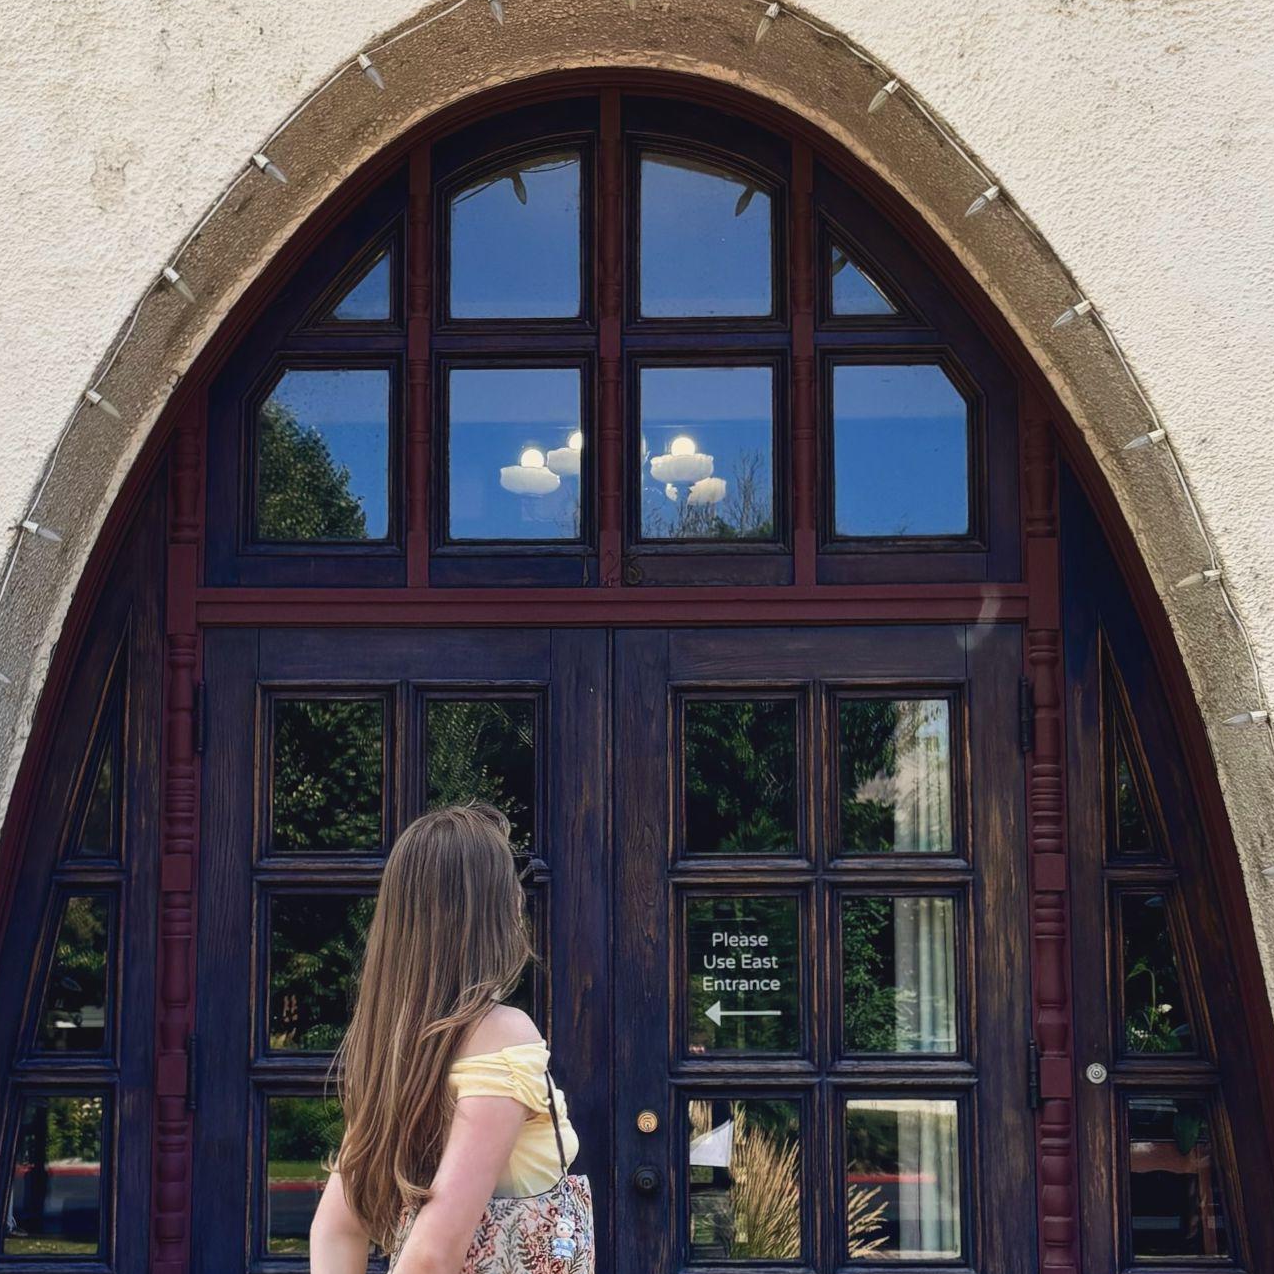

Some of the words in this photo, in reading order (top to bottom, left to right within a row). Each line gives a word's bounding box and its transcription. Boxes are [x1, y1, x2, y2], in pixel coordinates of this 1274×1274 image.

[712, 931, 769, 947] Please
[703, 954, 736, 969] Use
[741, 954, 779, 969] East
[702, 976, 781, 991] Entrance
